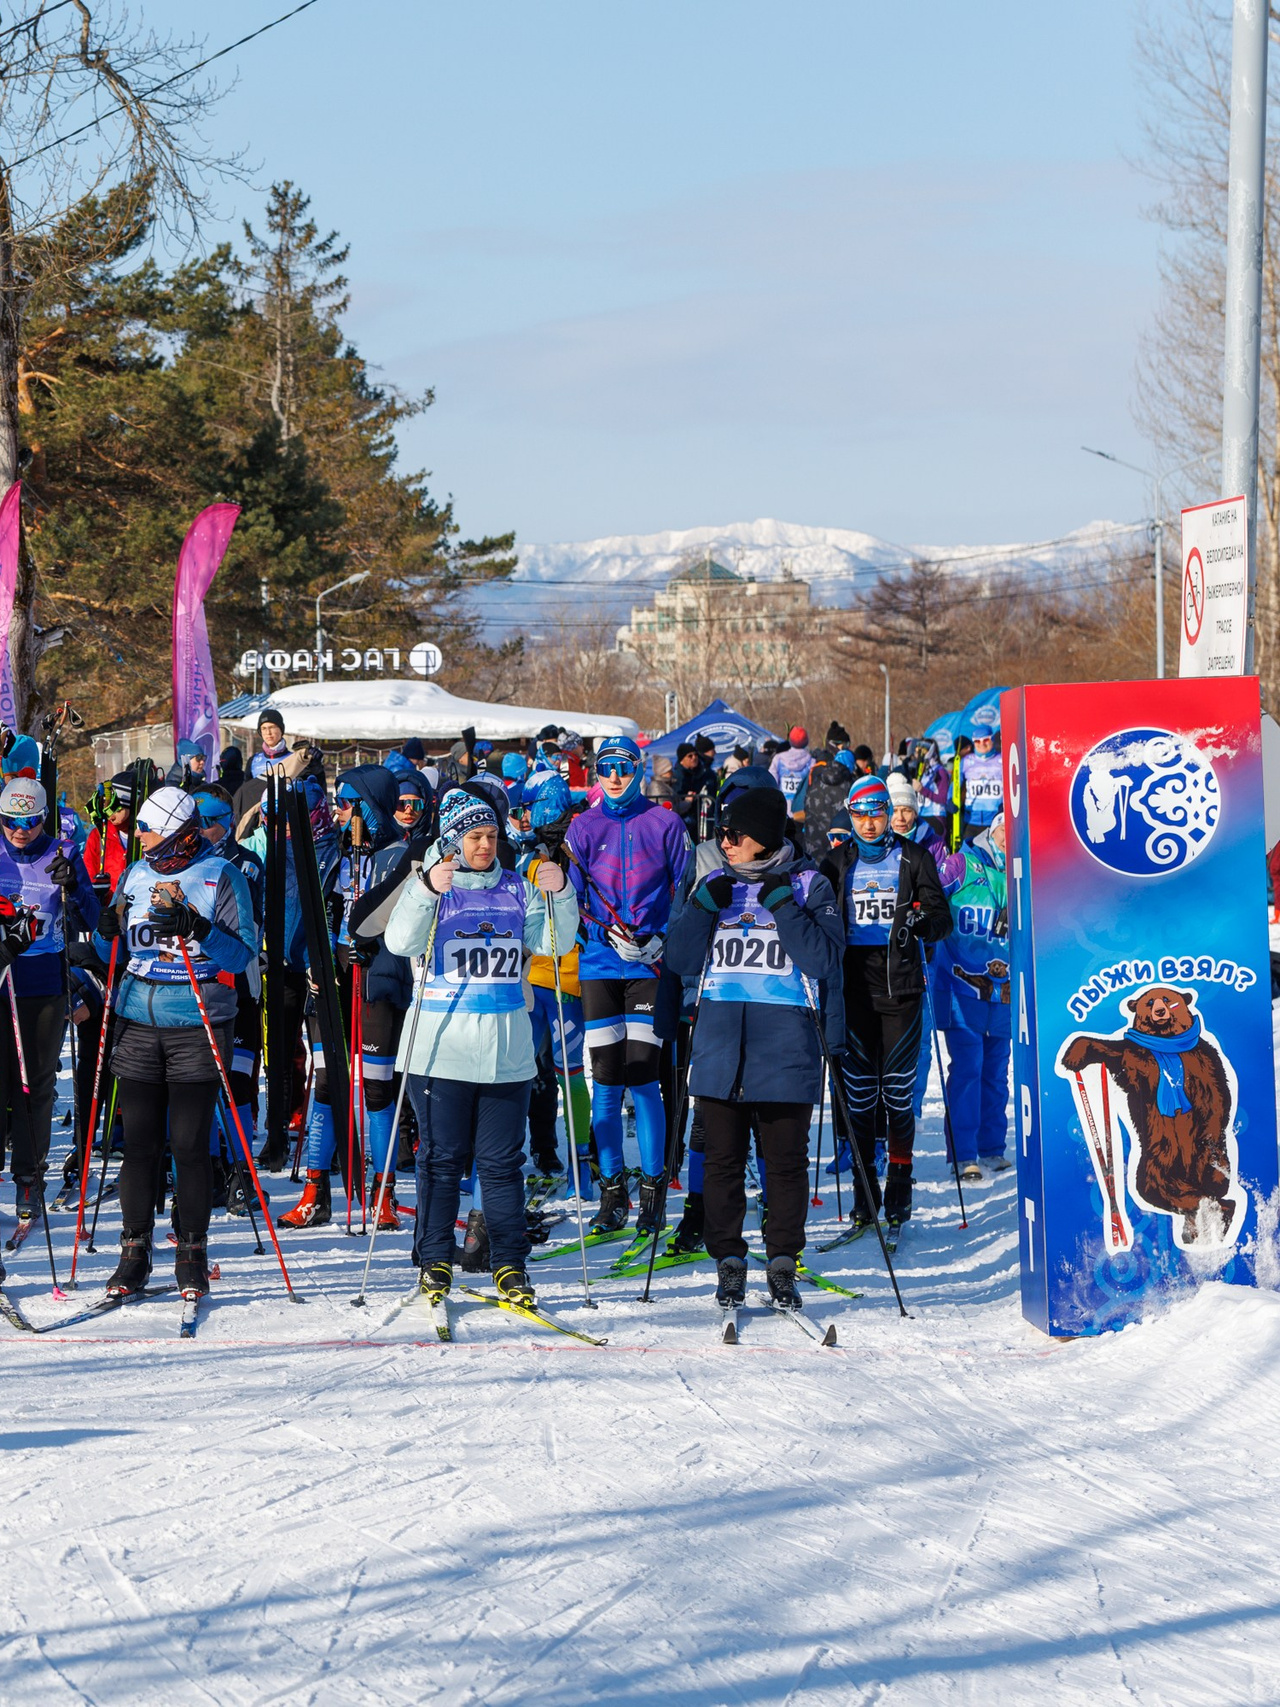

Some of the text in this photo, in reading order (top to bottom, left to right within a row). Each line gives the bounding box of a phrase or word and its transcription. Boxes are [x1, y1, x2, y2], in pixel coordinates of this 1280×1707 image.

[1231, 509, 1238, 523] НА
[1206, 546, 1237, 564] ВЕЛОСИПЕДАХ
[1216, 619, 1232, 634] ТРАССЕ
[972, 784, 1001, 796] 1049
[855, 899, 895, 920] 755
[431, 947, 519, 978] 1022
[714, 938, 786, 970] 1020
[1070, 958, 1254, 1020] ЛЫЖИ ВЗЯЛ?
